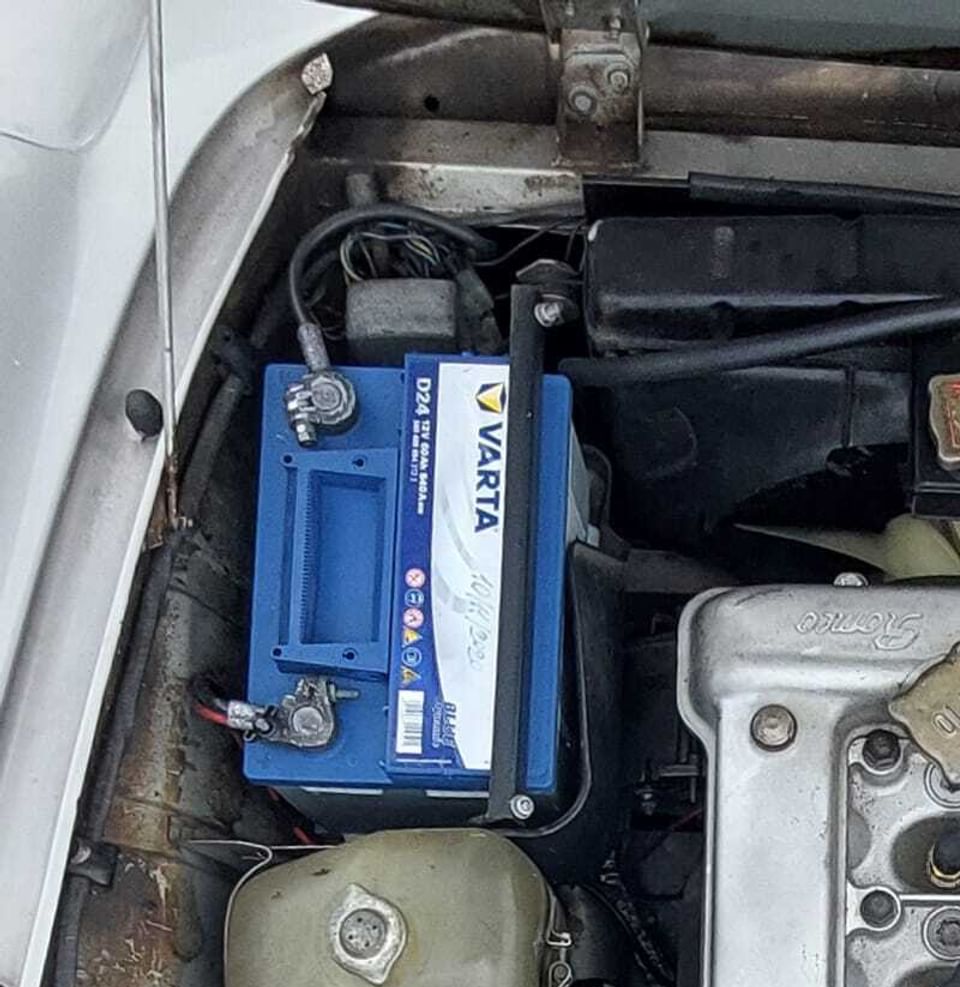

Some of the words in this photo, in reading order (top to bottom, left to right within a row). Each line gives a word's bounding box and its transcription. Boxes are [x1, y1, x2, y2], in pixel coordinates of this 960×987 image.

[414, 377, 432, 416] D24
[420, 419, 430, 440] 12V
[474, 422, 503, 533] VARTA
[794, 611, 924, 652] Romeo
[441, 702, 457, 748] BLUE
